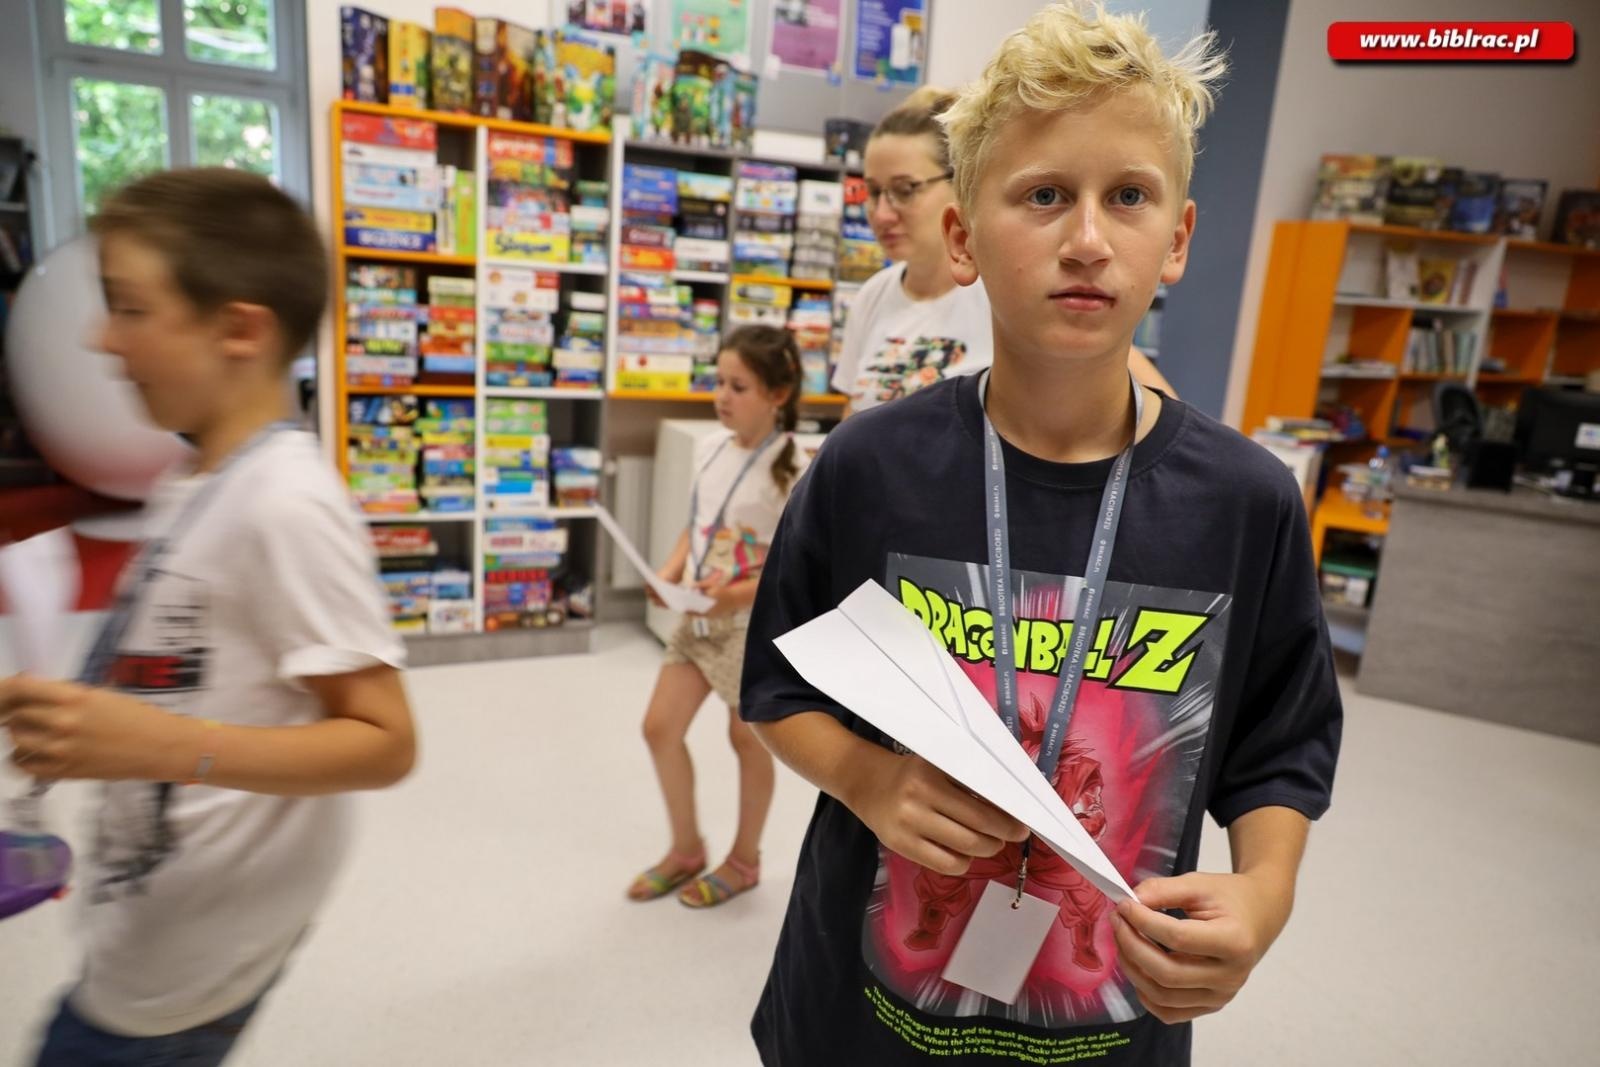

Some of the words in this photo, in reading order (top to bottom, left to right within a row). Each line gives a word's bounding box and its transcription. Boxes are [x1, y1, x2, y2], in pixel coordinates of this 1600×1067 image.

[993, 528, 1003, 568] RACIBORZU
[997, 578, 1006, 617] BIBLIOTEKA
[1072, 626, 1087, 664] BIBLIOTEKA
[1106, 607, 1216, 695] Z
[1058, 672, 1075, 713] RACIBORZU
[905, 1013, 932, 1034] Dragon
[934, 1027, 950, 1036] Ball
[961, 1026, 977, 1036] and
[978, 1026, 992, 1036] the
[994, 1030, 1015, 1039] most
[1017, 1034, 1057, 1046] powerful
[1058, 1036, 1086, 1046] warrior
[1099, 1031, 1120, 1041] Earth
[924, 1033, 949, 1046] When
[950, 1037, 964, 1047] the
[965, 1036, 996, 1046] Saiyans
[1027, 1045, 1051, 1056] Goku
[1052, 1047, 1075, 1055] learns
[1090, 1037, 1131, 1050] mysterious
[911, 1040, 928, 1053] own
[953, 1047, 963, 1056] he
[980, 1045, 1008, 1056] Saiyan
[1008, 1050, 1048, 1066] originally
[1049, 1053, 1076, 1064] named
